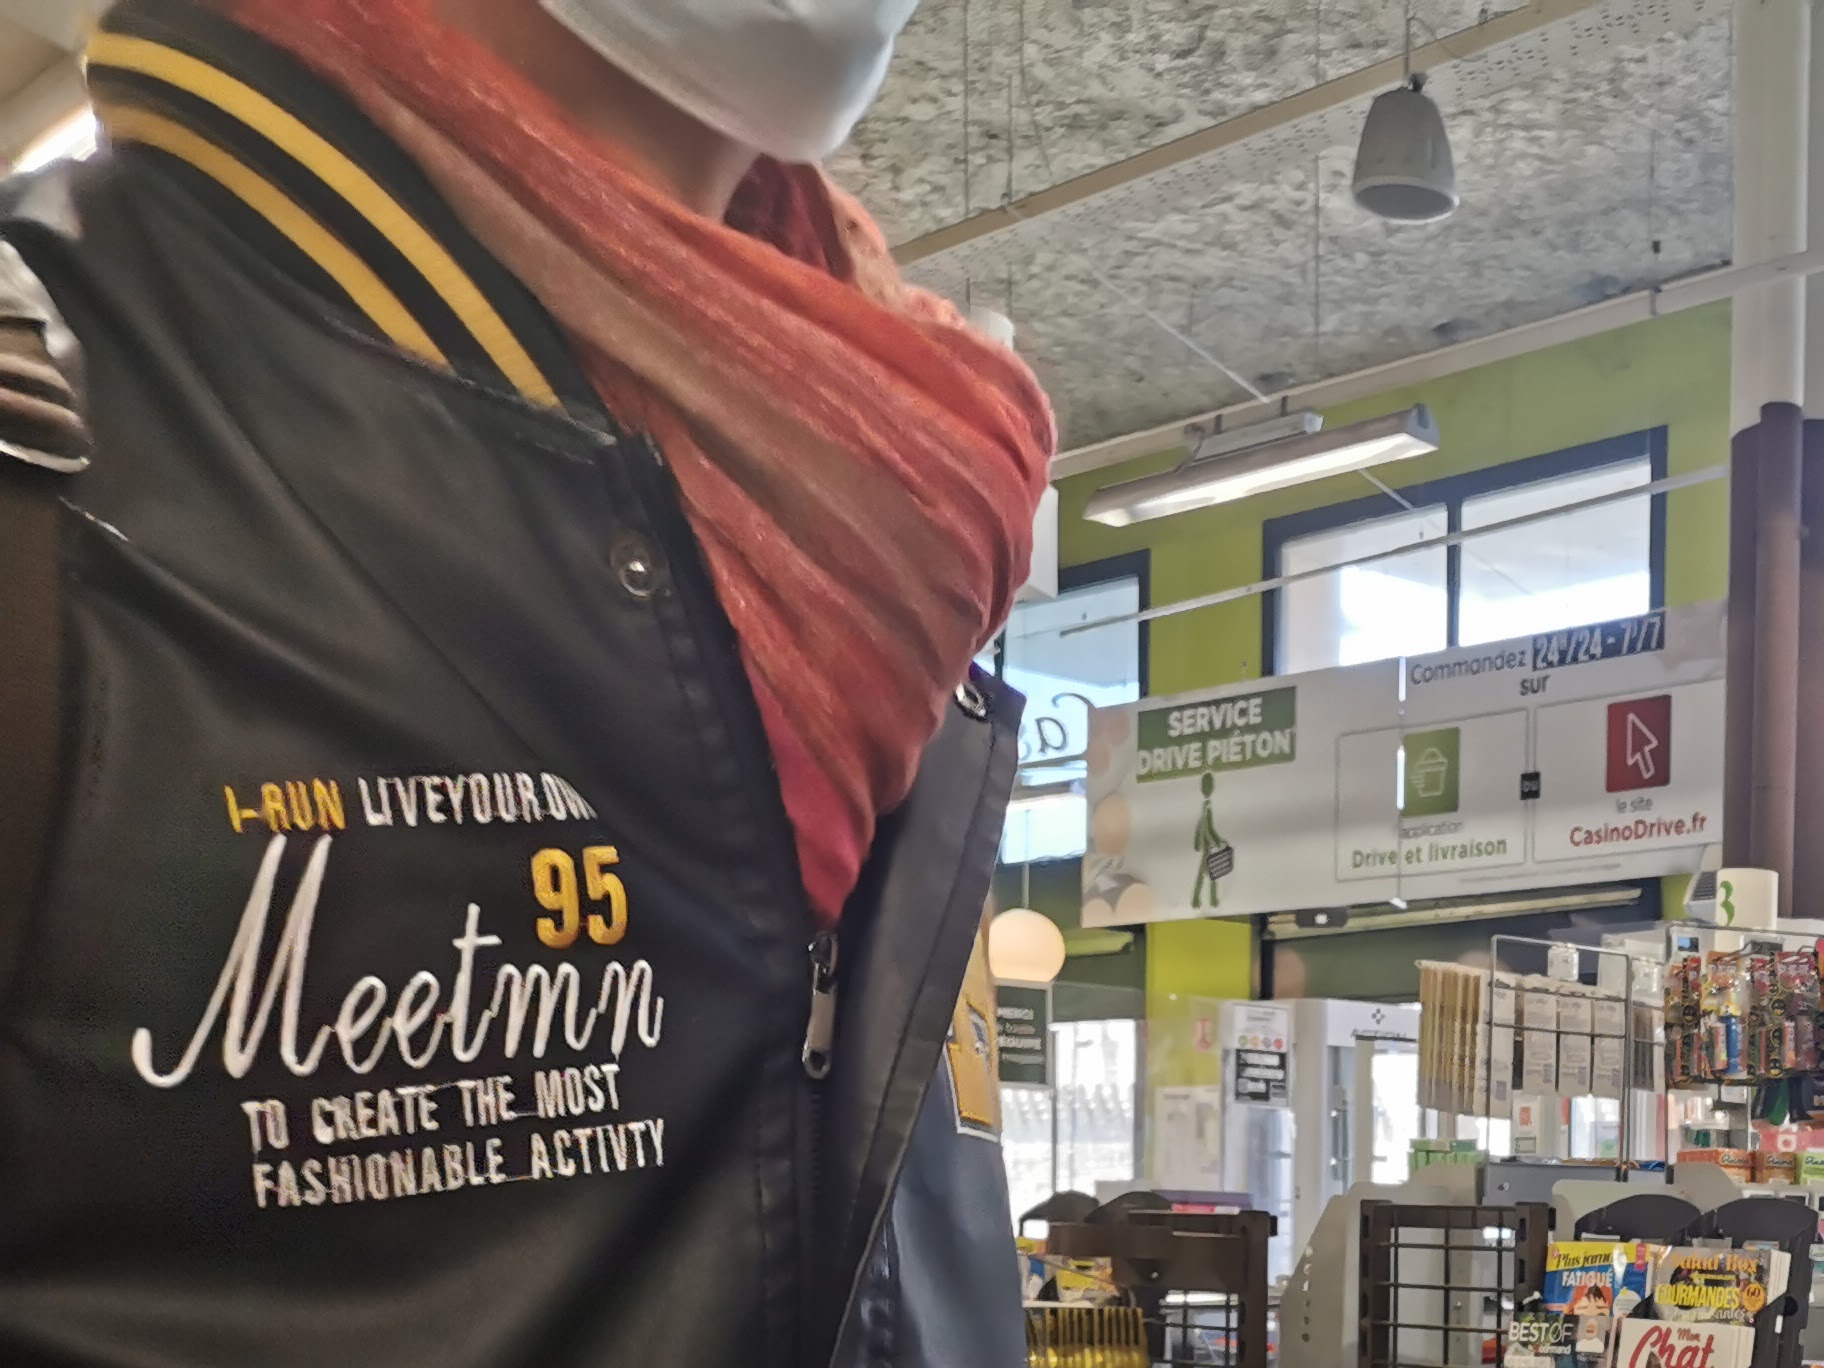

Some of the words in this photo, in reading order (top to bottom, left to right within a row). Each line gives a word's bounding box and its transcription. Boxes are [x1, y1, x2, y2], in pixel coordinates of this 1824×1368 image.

[1411, 648, 1527, 685] Commandez
[1520, 675, 1550, 696] sur
[1168, 698, 1263, 737] SERVICE
[1138, 743, 1201, 773] DRIVE
[1206, 726, 1293, 764] PIÉTON
[1570, 811, 1708, 847] CasinoDrive.fr
[1352, 849, 1397, 869] Drive
[1406, 845, 1423, 864] et
[1429, 837, 1507, 860] livraison
[530, 845, 627, 949] 95
[241, 1099, 289, 1152] TO
[311, 1083, 439, 1144] CREATE
[459, 1076, 516, 1126] THE
[534, 1063, 620, 1118] MOST
[253, 1138, 505, 1208] FASHIONABLE
[1508, 1321, 1549, 1342] BEST
[1550, 1322, 1575, 1343] OF
